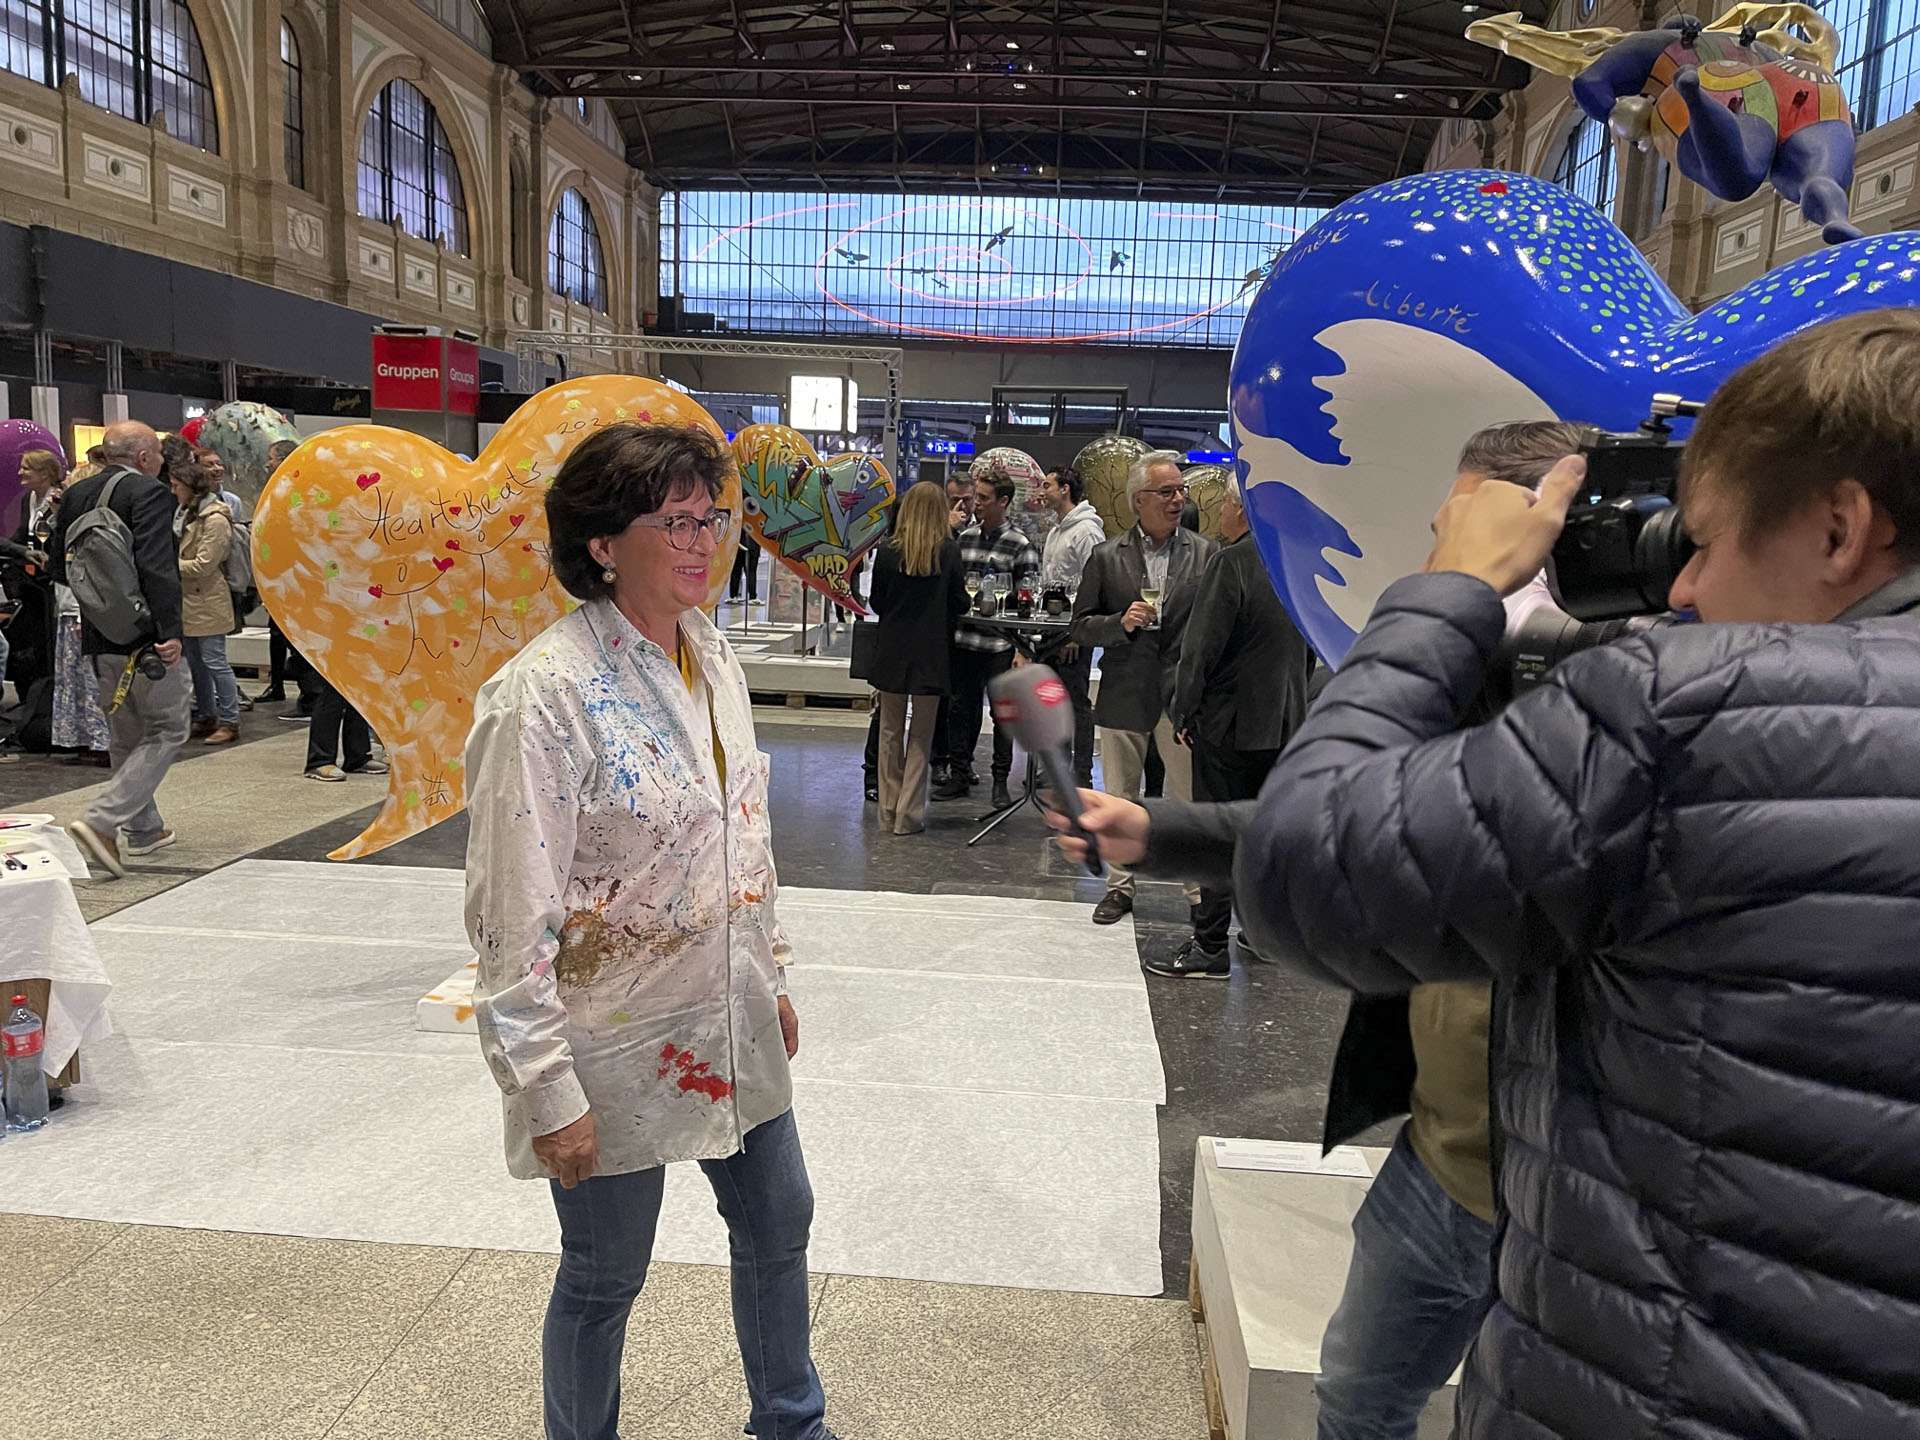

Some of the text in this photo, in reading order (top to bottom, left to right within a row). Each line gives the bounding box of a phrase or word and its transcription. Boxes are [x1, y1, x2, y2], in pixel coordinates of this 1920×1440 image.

[377, 363, 439, 380] Gruppen
[450, 368, 475, 385] Groups
[805, 553, 849, 577] MAD
